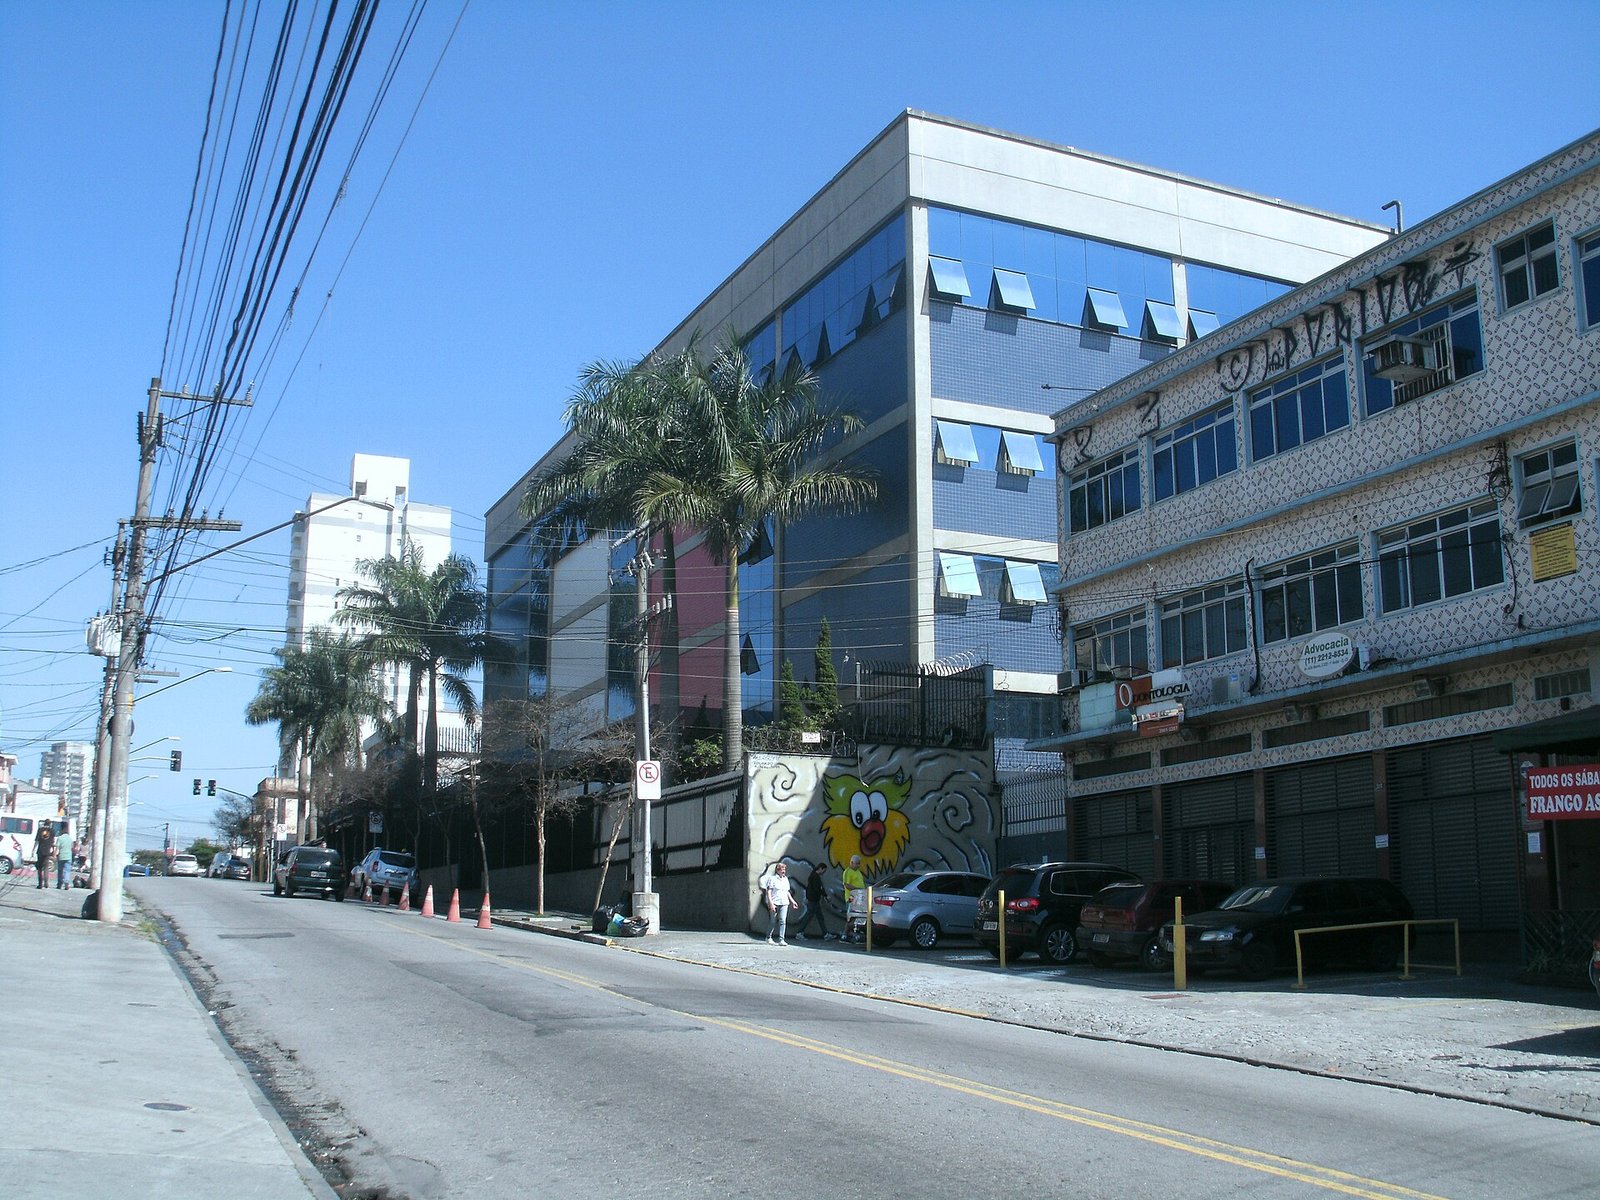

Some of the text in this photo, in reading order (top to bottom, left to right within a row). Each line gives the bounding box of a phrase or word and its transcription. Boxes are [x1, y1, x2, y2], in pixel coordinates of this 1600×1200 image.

[1304, 637, 1349, 655] Advocacia
[1304, 656, 1316, 667] (11)
[1529, 774, 1558, 788] TODOS
[1561, 772, 1574, 787] OS
[1530, 792, 1600, 813] FRANGO AS
